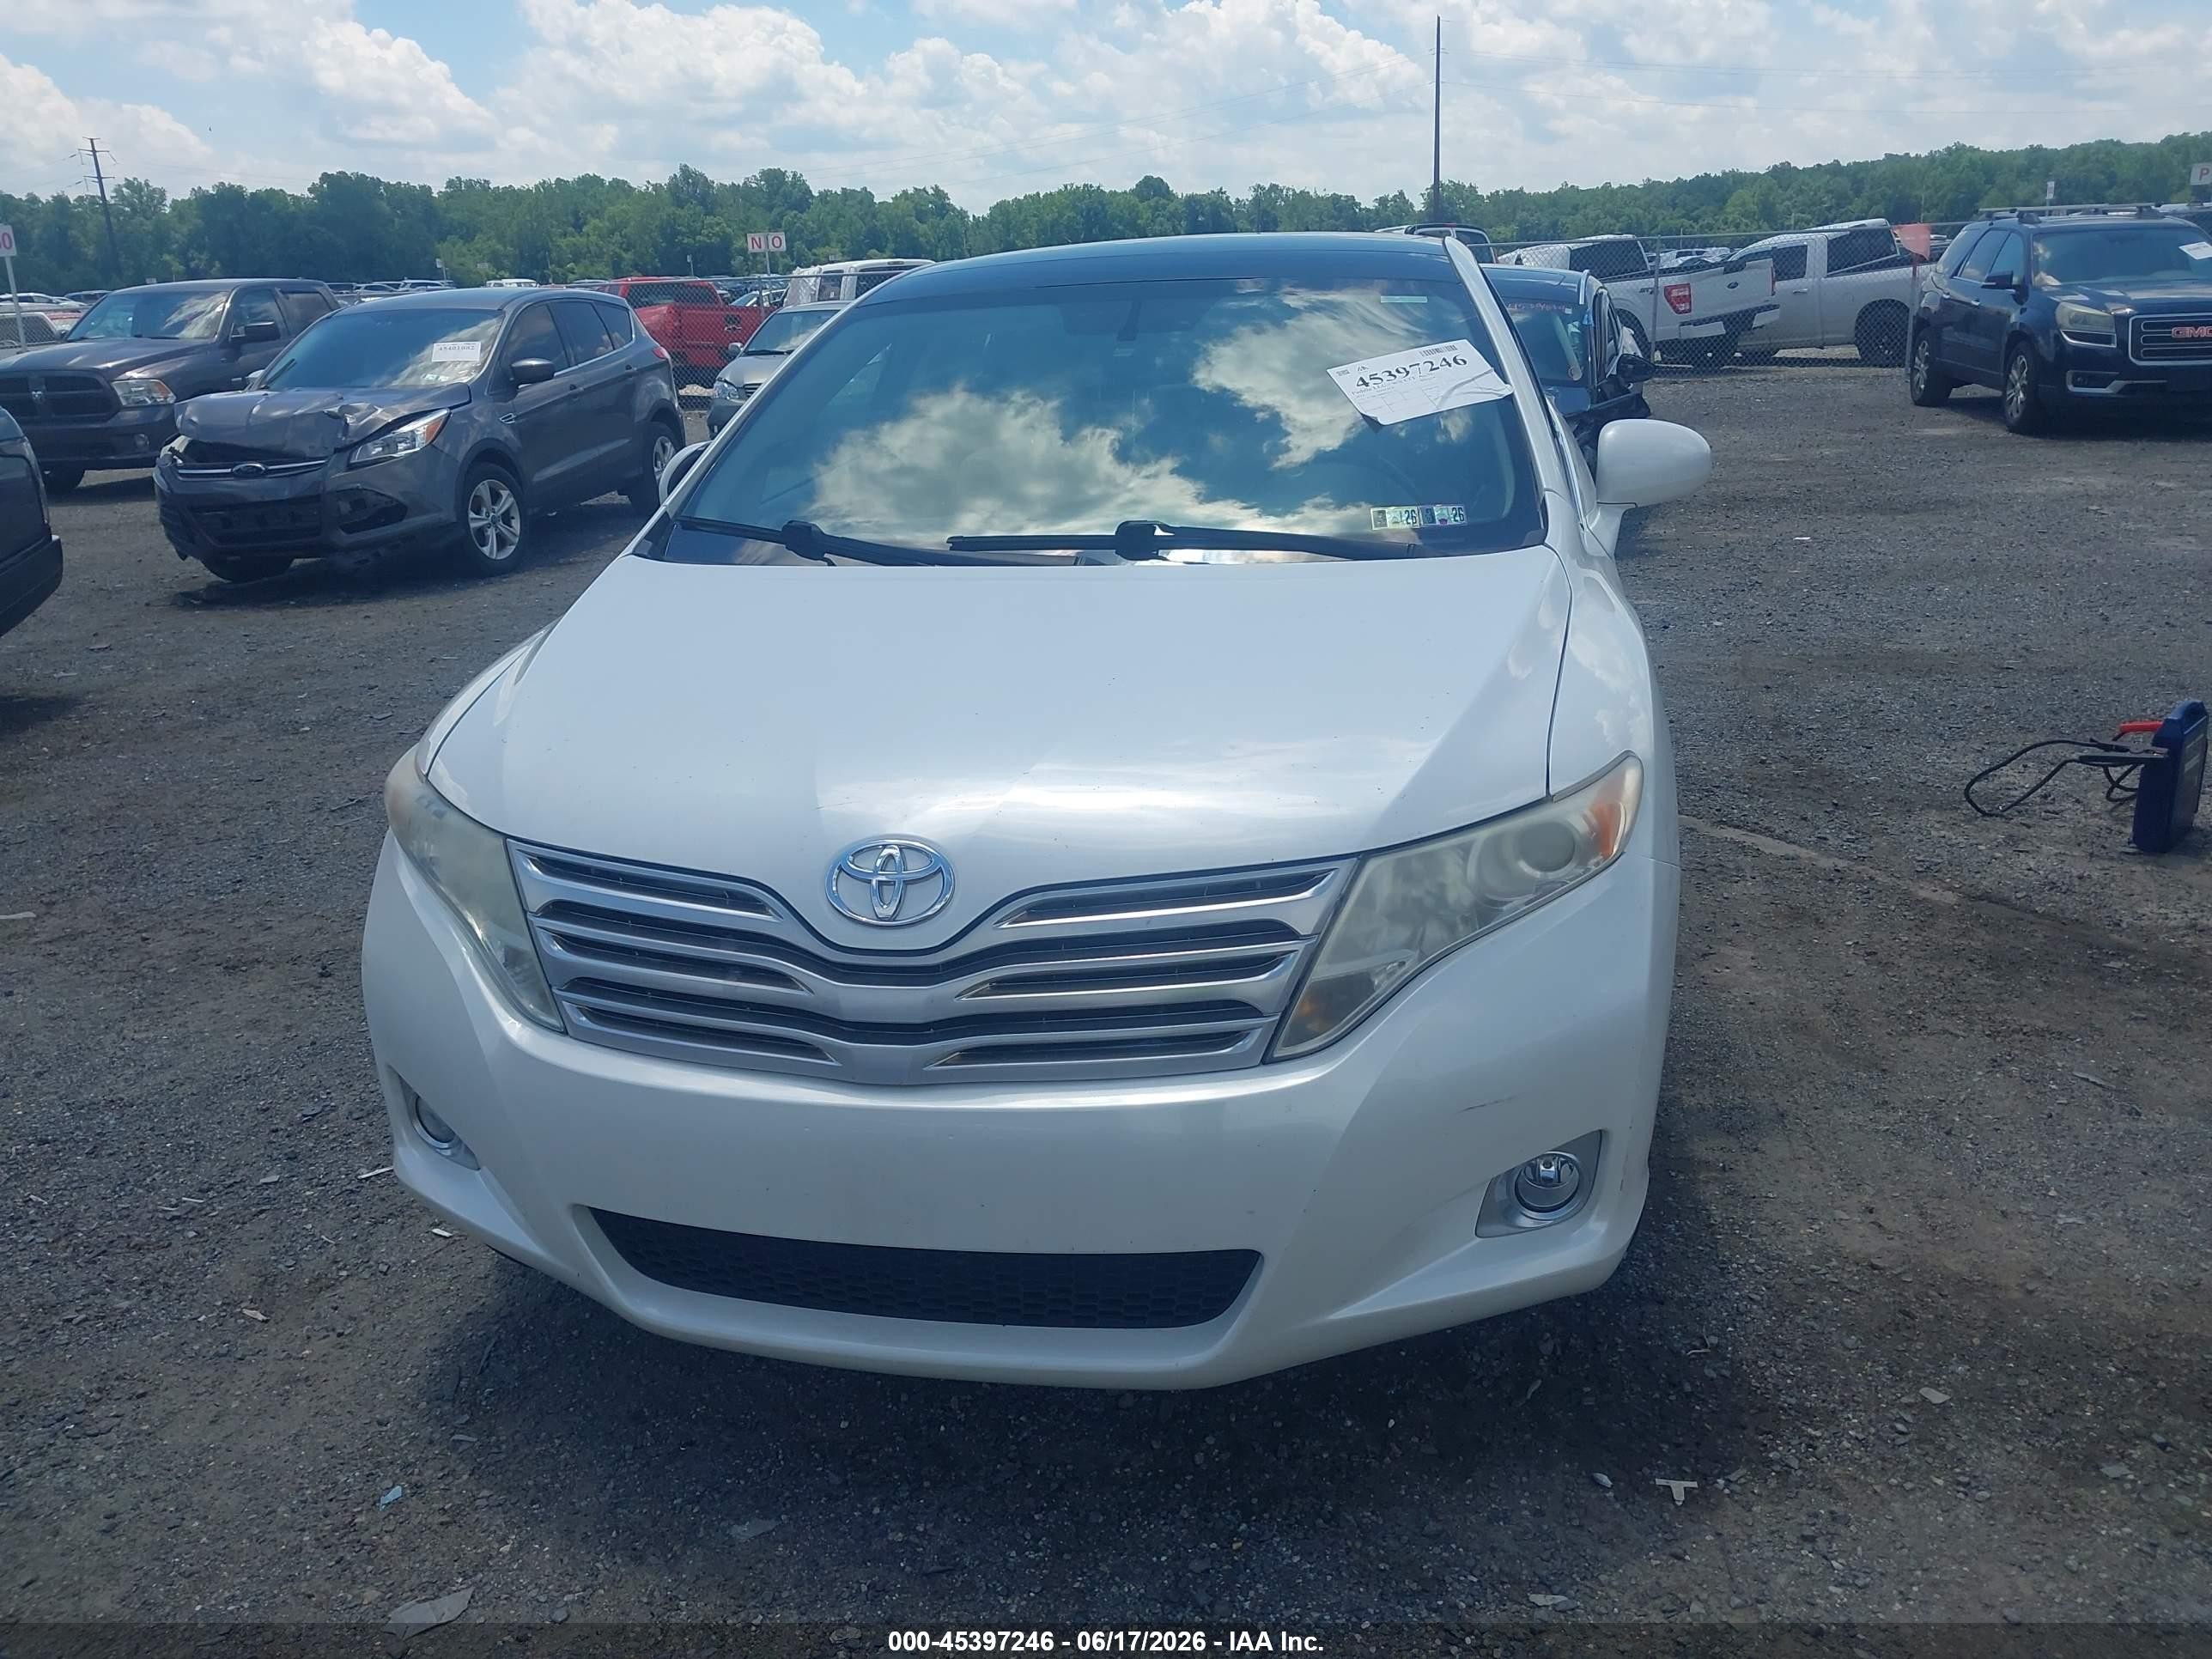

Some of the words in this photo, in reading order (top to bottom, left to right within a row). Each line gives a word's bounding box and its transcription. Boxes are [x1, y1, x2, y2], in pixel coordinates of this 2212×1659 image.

[2199, 167, 2210, 181] P
[1356, 353, 1468, 388] 45397246
[1404, 505, 1417, 525] 26
[1451, 506, 1465, 523] 26
